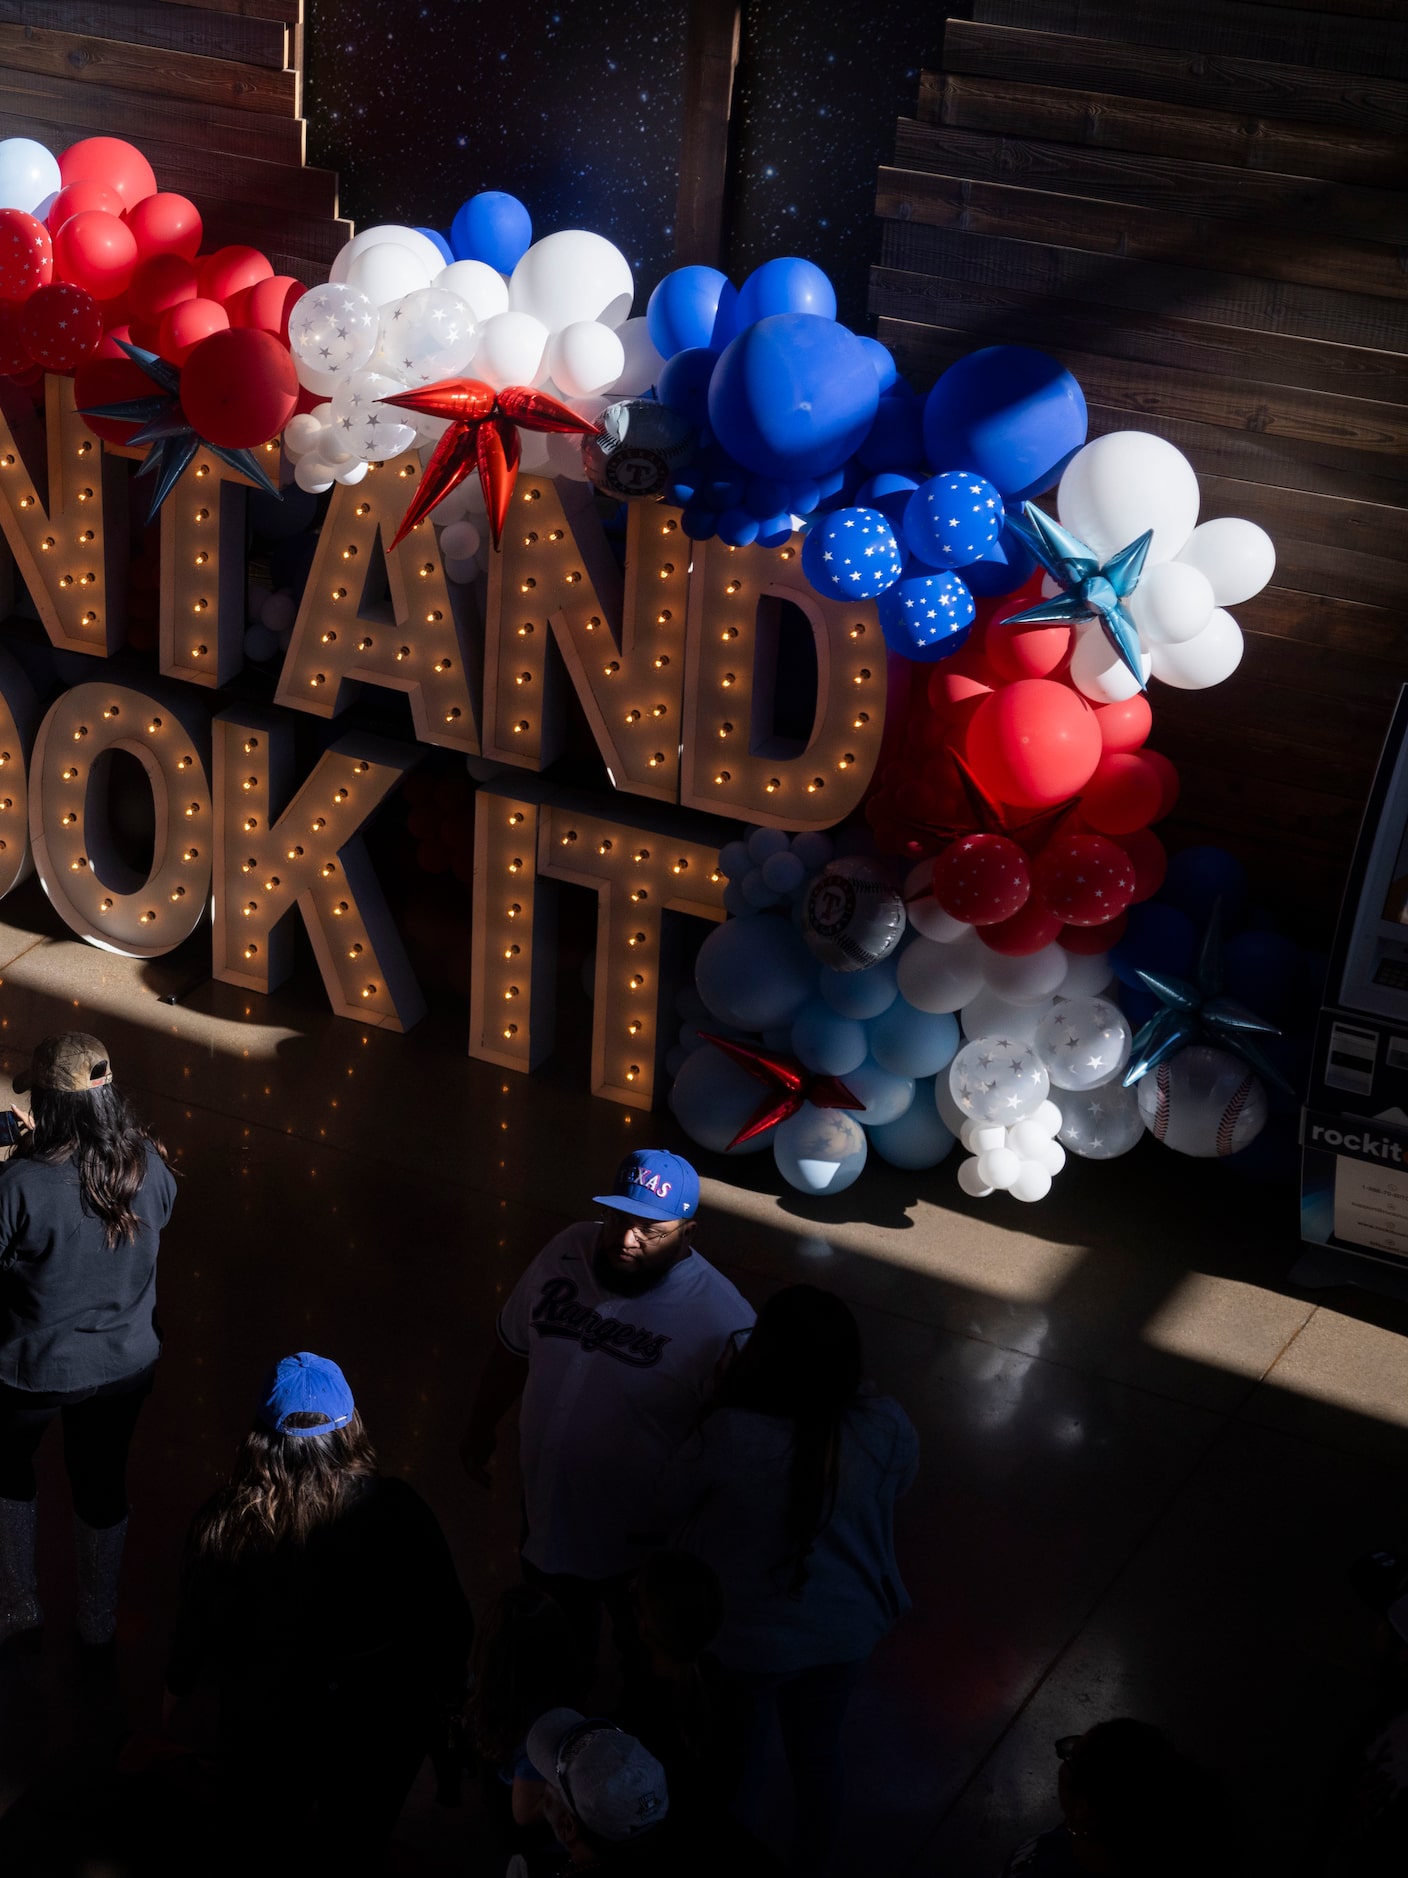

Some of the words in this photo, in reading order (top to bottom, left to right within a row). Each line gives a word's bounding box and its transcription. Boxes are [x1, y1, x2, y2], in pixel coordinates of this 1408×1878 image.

[274, 455, 890, 832] AND
[468, 776, 729, 1112] IT
[1312, 1125, 1403, 1163] rockit
[531, 1276, 672, 1360] Rangers
